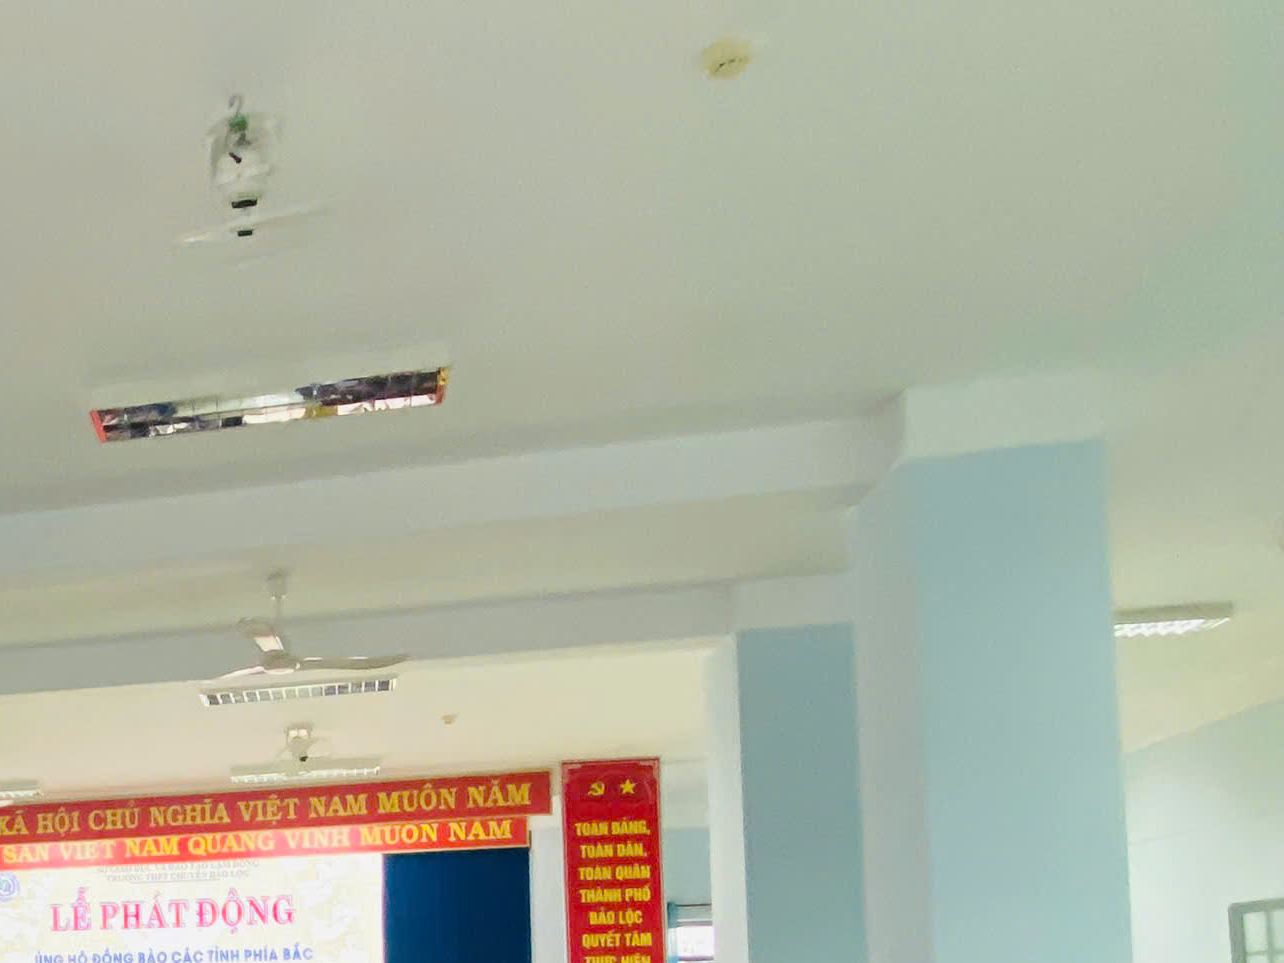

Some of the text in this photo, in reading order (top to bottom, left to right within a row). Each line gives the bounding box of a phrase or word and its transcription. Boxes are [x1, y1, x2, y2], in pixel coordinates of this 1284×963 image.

[37, 806, 81, 839] HỘI
[88, 800, 139, 830] CHỦ
[149, 798, 231, 828] NGHĨA
[237, 793, 300, 825] VIỆT
[309, 793, 368, 819] NAM
[377, 783, 458, 814] MUÔN
[467, 779, 532, 808] NĂM
[124, 837, 180, 858] NAM
[187, 831, 275, 856] QUANG
[285, 827, 350, 849] VINH
[580, 884, 652, 903] THÀNH PHỐ
[50, 886, 297, 935] LỄ PHÁT ĐỘNG
[589, 907, 643, 927] BẢO LỘC
[582, 929, 653, 949] QUYẾT TÂM
[171, 946, 204, 963] CÁC
[244, 943, 279, 962] PHÍA
[283, 942, 314, 961] BẮC
